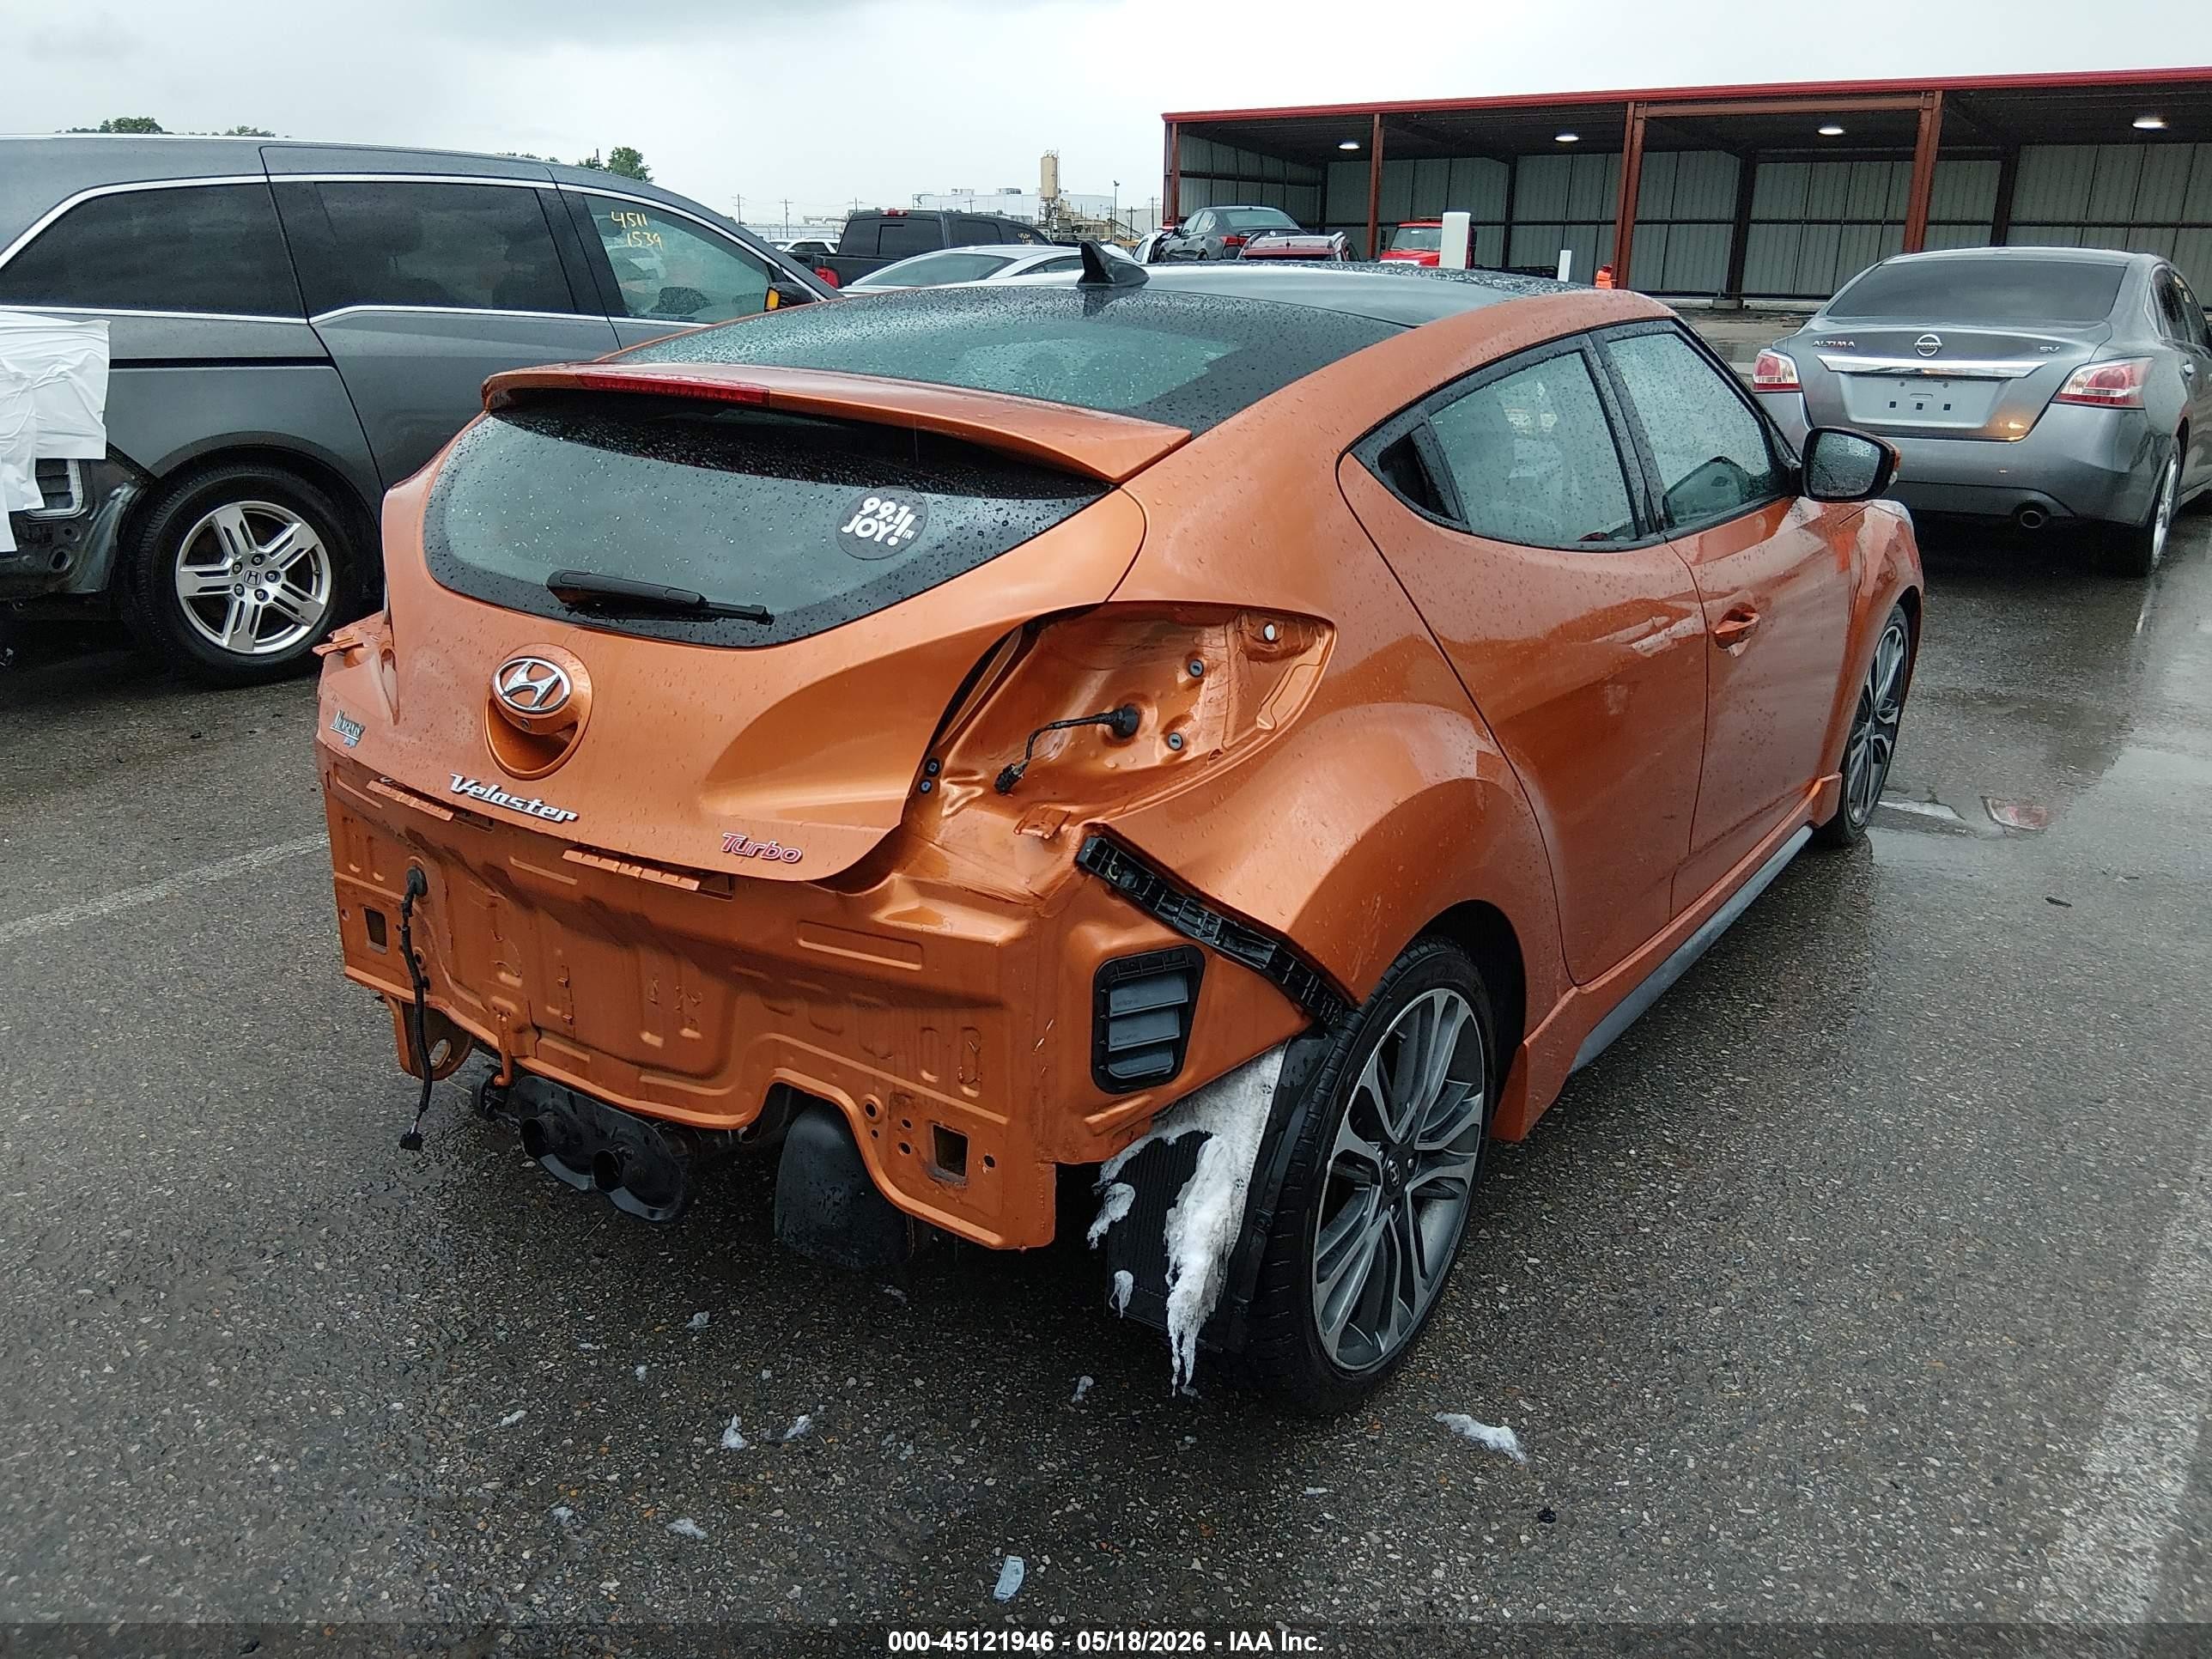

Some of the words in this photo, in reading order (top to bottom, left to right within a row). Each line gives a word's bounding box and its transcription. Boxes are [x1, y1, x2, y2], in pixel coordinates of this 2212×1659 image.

[611, 210, 648, 228] 4511
[627, 231, 664, 251] 1539
[859, 497, 910, 526] 99.1
[841, 514, 916, 546] JOY!
[449, 773, 579, 823] Veloster
[721, 832, 803, 863] Turbo
